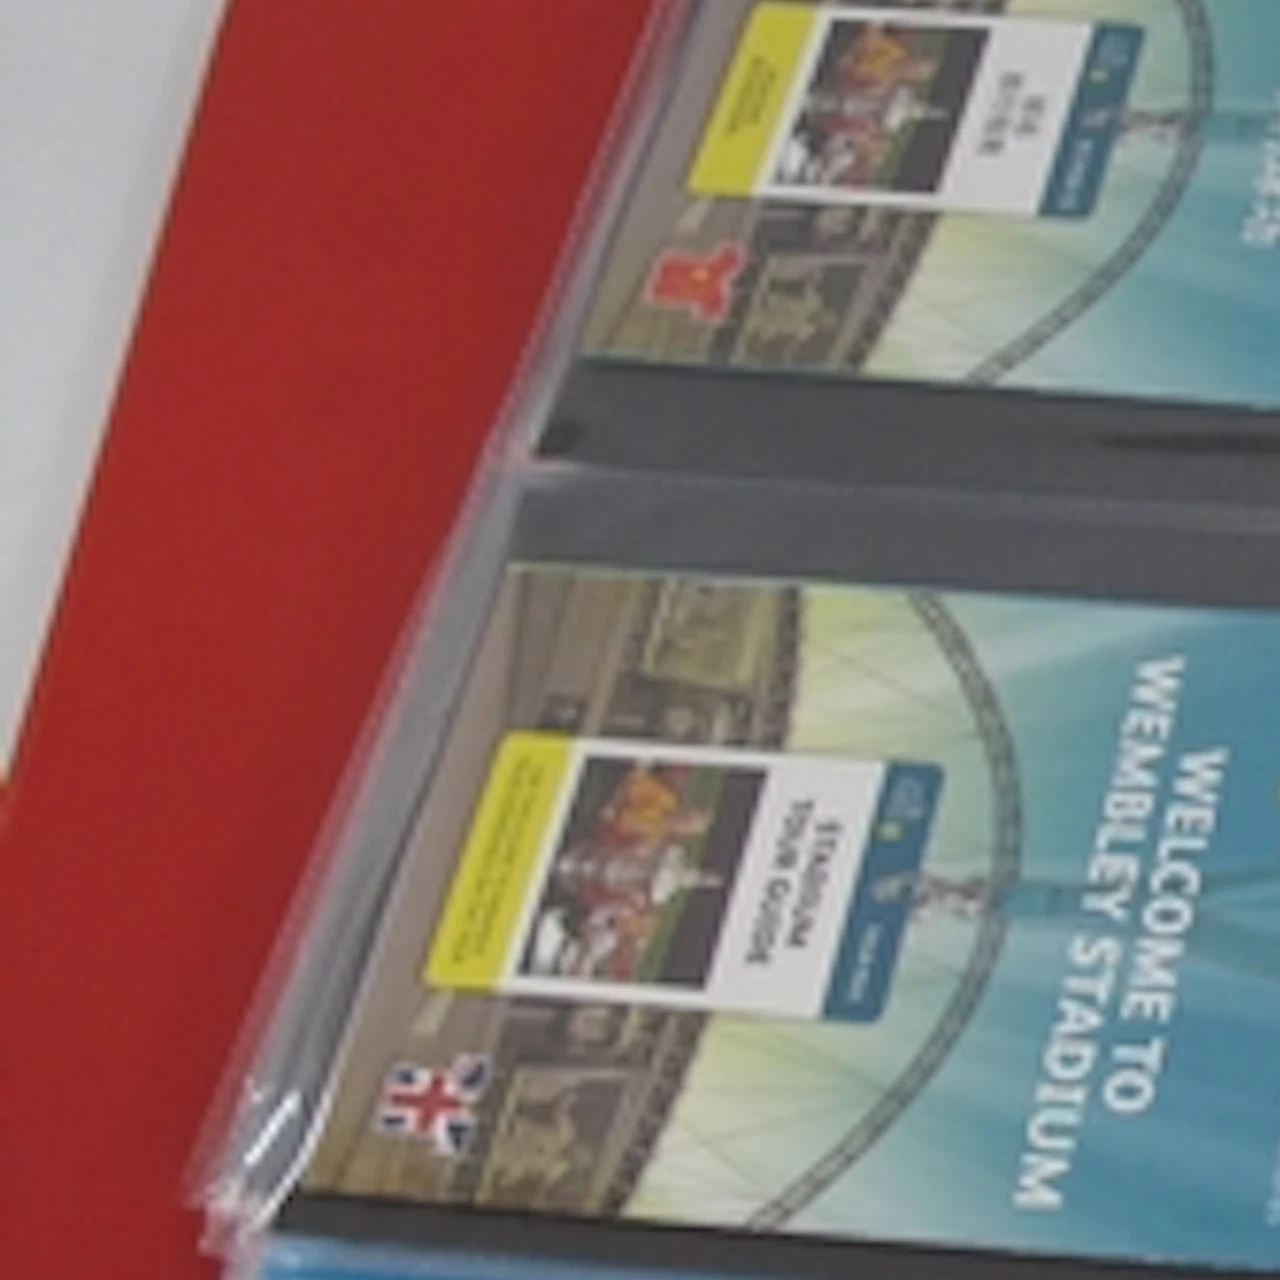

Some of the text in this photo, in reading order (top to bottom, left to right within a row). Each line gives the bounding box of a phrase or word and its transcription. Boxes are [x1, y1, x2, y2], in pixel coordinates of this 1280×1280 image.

[747, 800, 813, 963] TOUR GUIDE
[789, 818, 841, 947] STADIUM
[1012, 653, 1187, 1212] WEMBLEY STADIUM
[1102, 746, 1230, 1116] WELCOME TO
